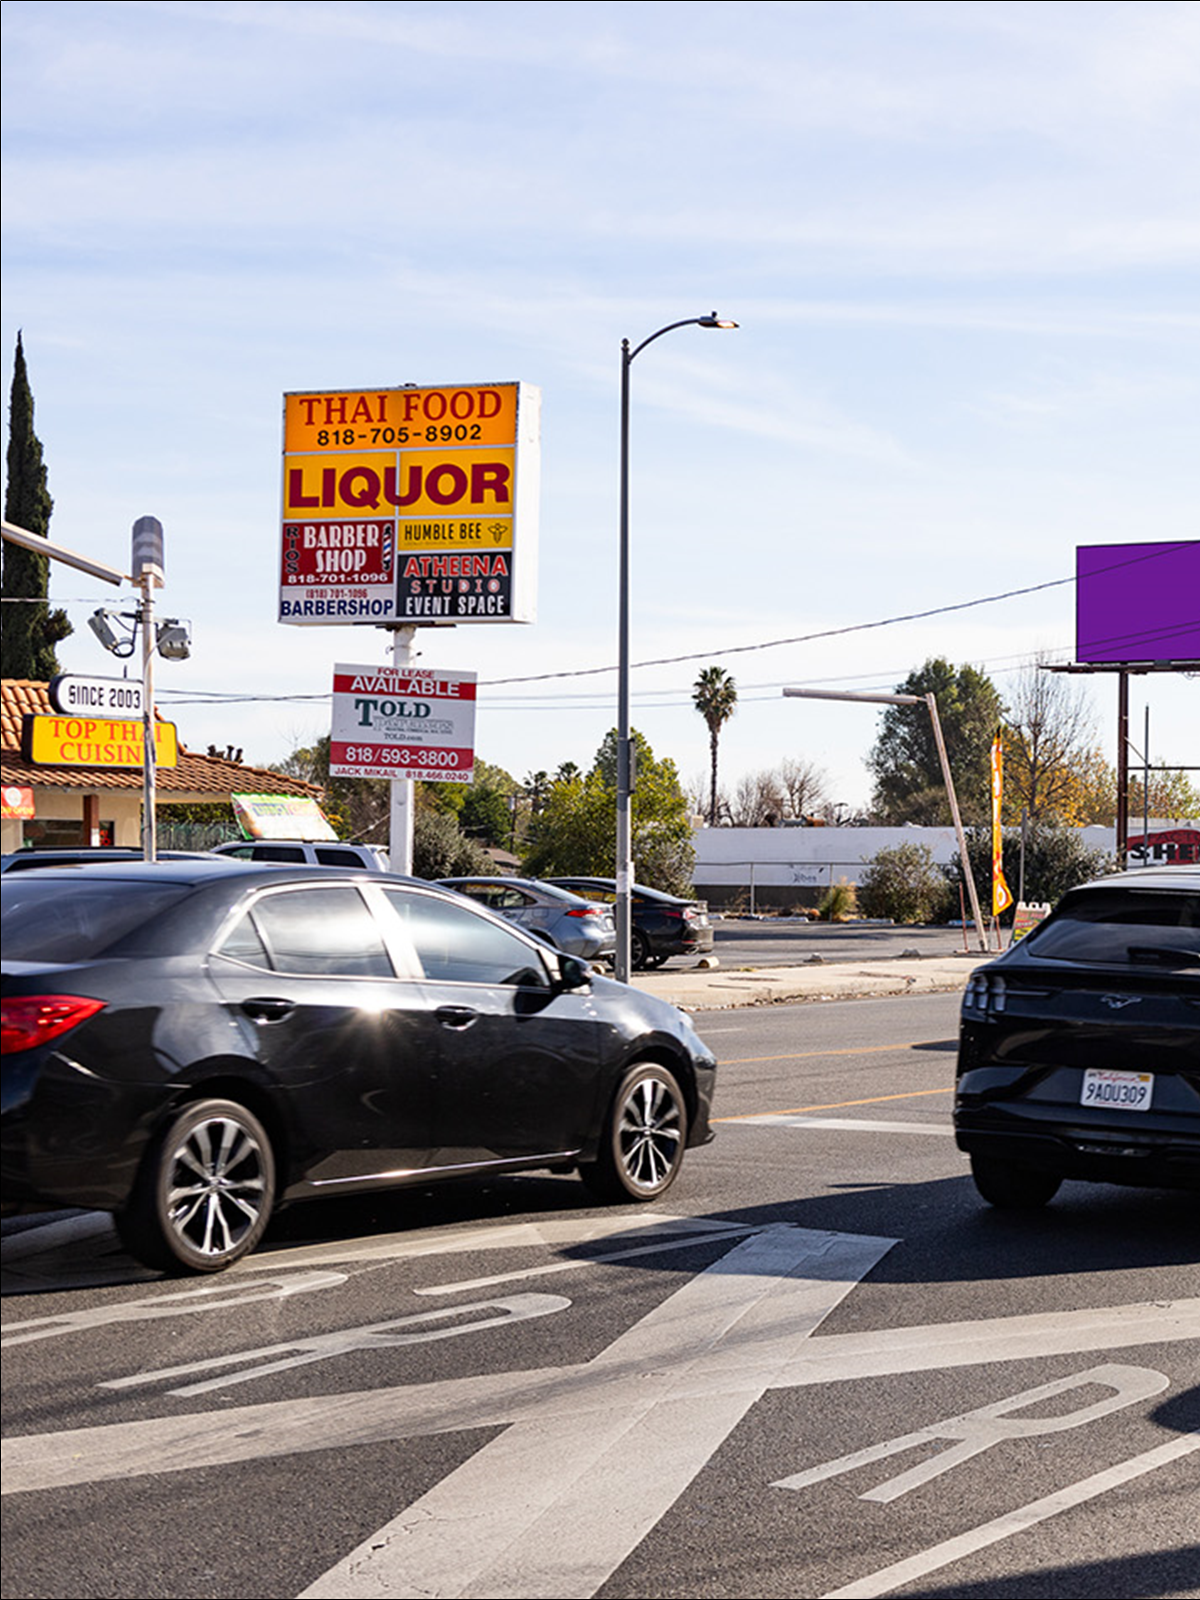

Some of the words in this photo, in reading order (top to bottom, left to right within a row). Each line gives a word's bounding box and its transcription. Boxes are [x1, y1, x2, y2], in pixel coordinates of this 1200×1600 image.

[299, 395, 388, 425] THAI
[403, 390, 502, 422] FOOD
[317, 424, 482, 446] 818-705-8902
[288, 463, 511, 510] LIQUOR
[303, 524, 380, 548] BARBER
[404, 523, 454, 541] HUMBLE
[460, 522, 482, 540] BEE
[315, 549, 367, 573] SHOP
[403, 555, 508, 577] ATHEENA
[287, 573, 388, 584] 818-701-1096
[410, 579, 500, 594] STUDIO
[280, 599, 394, 616] BARBERSHOP
[406, 596, 451, 615] EVENT
[457, 595, 505, 615] SPACE
[377, 667, 399, 677] FOR
[401, 669, 435, 679] LEASE
[68, 685, 104, 707] SINCE
[109, 688, 141, 709] 2003
[350, 675, 461, 697] AVAILABLE
[354, 698, 431, 727] TOLD
[49, 719, 97, 739] TOP
[59, 741, 142, 763] CUISIN
[346, 746, 459, 767] 818/593-3800
[334, 767, 362, 776] JACK
